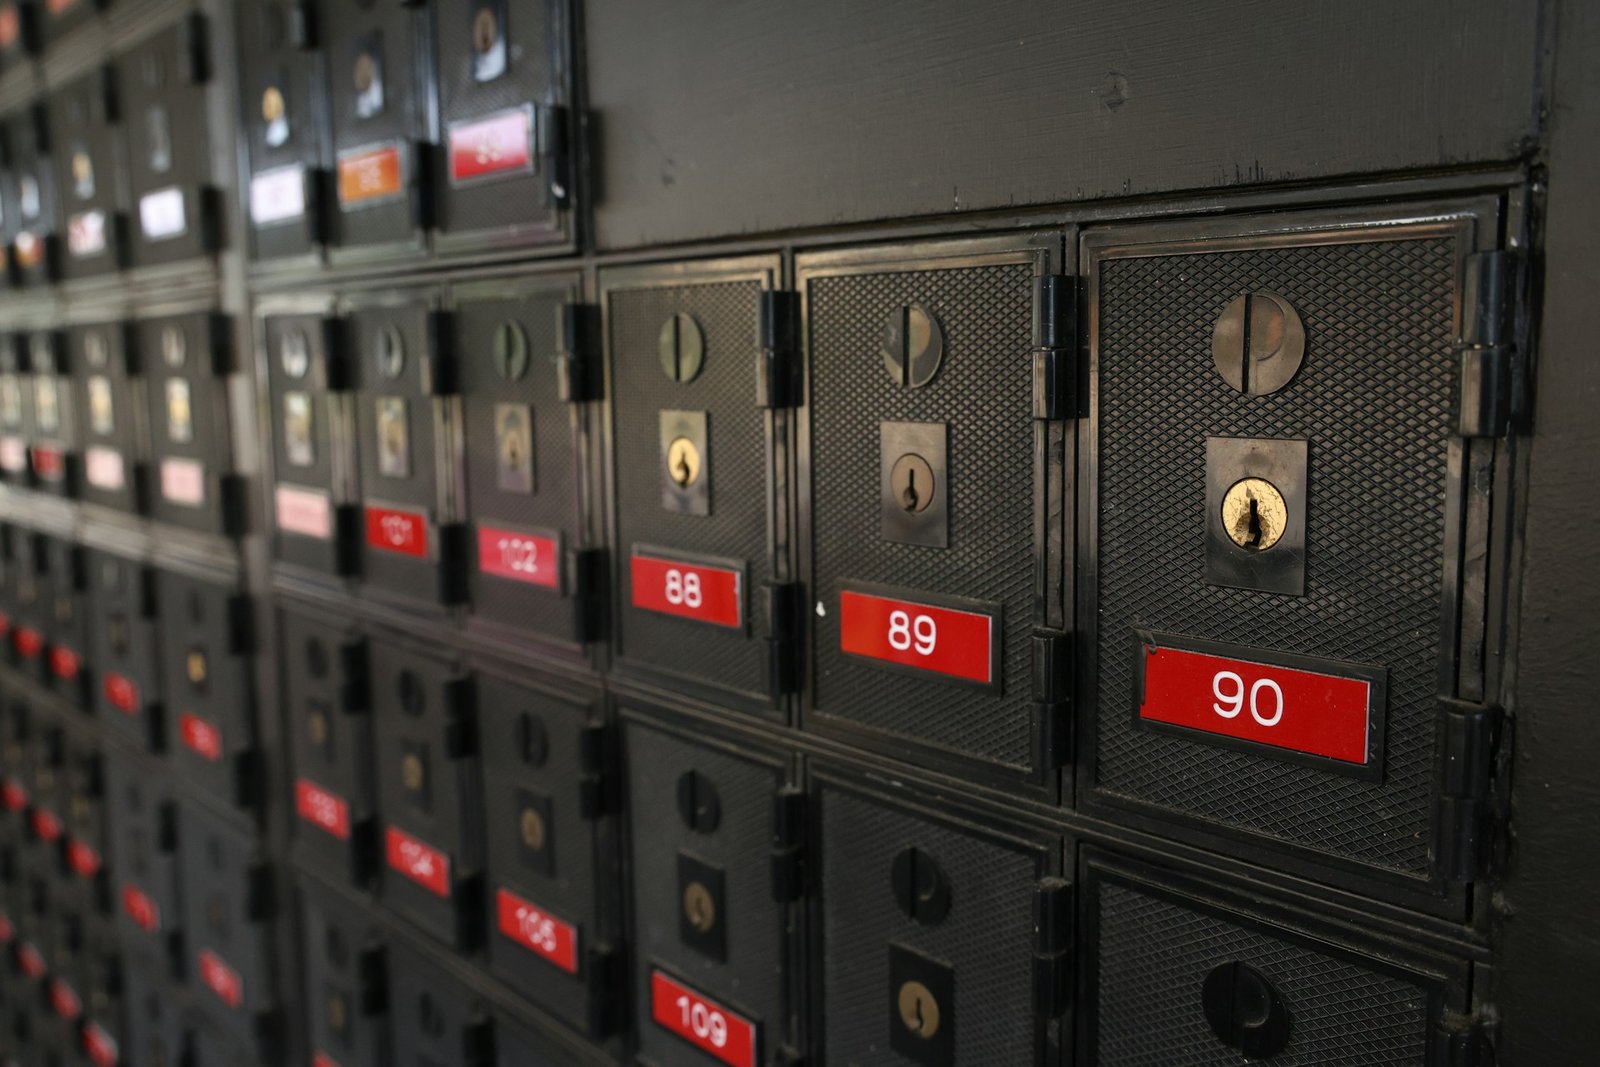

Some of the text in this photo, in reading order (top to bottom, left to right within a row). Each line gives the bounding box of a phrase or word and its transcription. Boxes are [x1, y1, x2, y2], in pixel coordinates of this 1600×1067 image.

[497, 537, 538, 573] 102
[665, 569, 702, 608] 88
[888, 610, 936, 656] 89
[1213, 671, 1284, 727] 90
[676, 996, 728, 1048] 109
